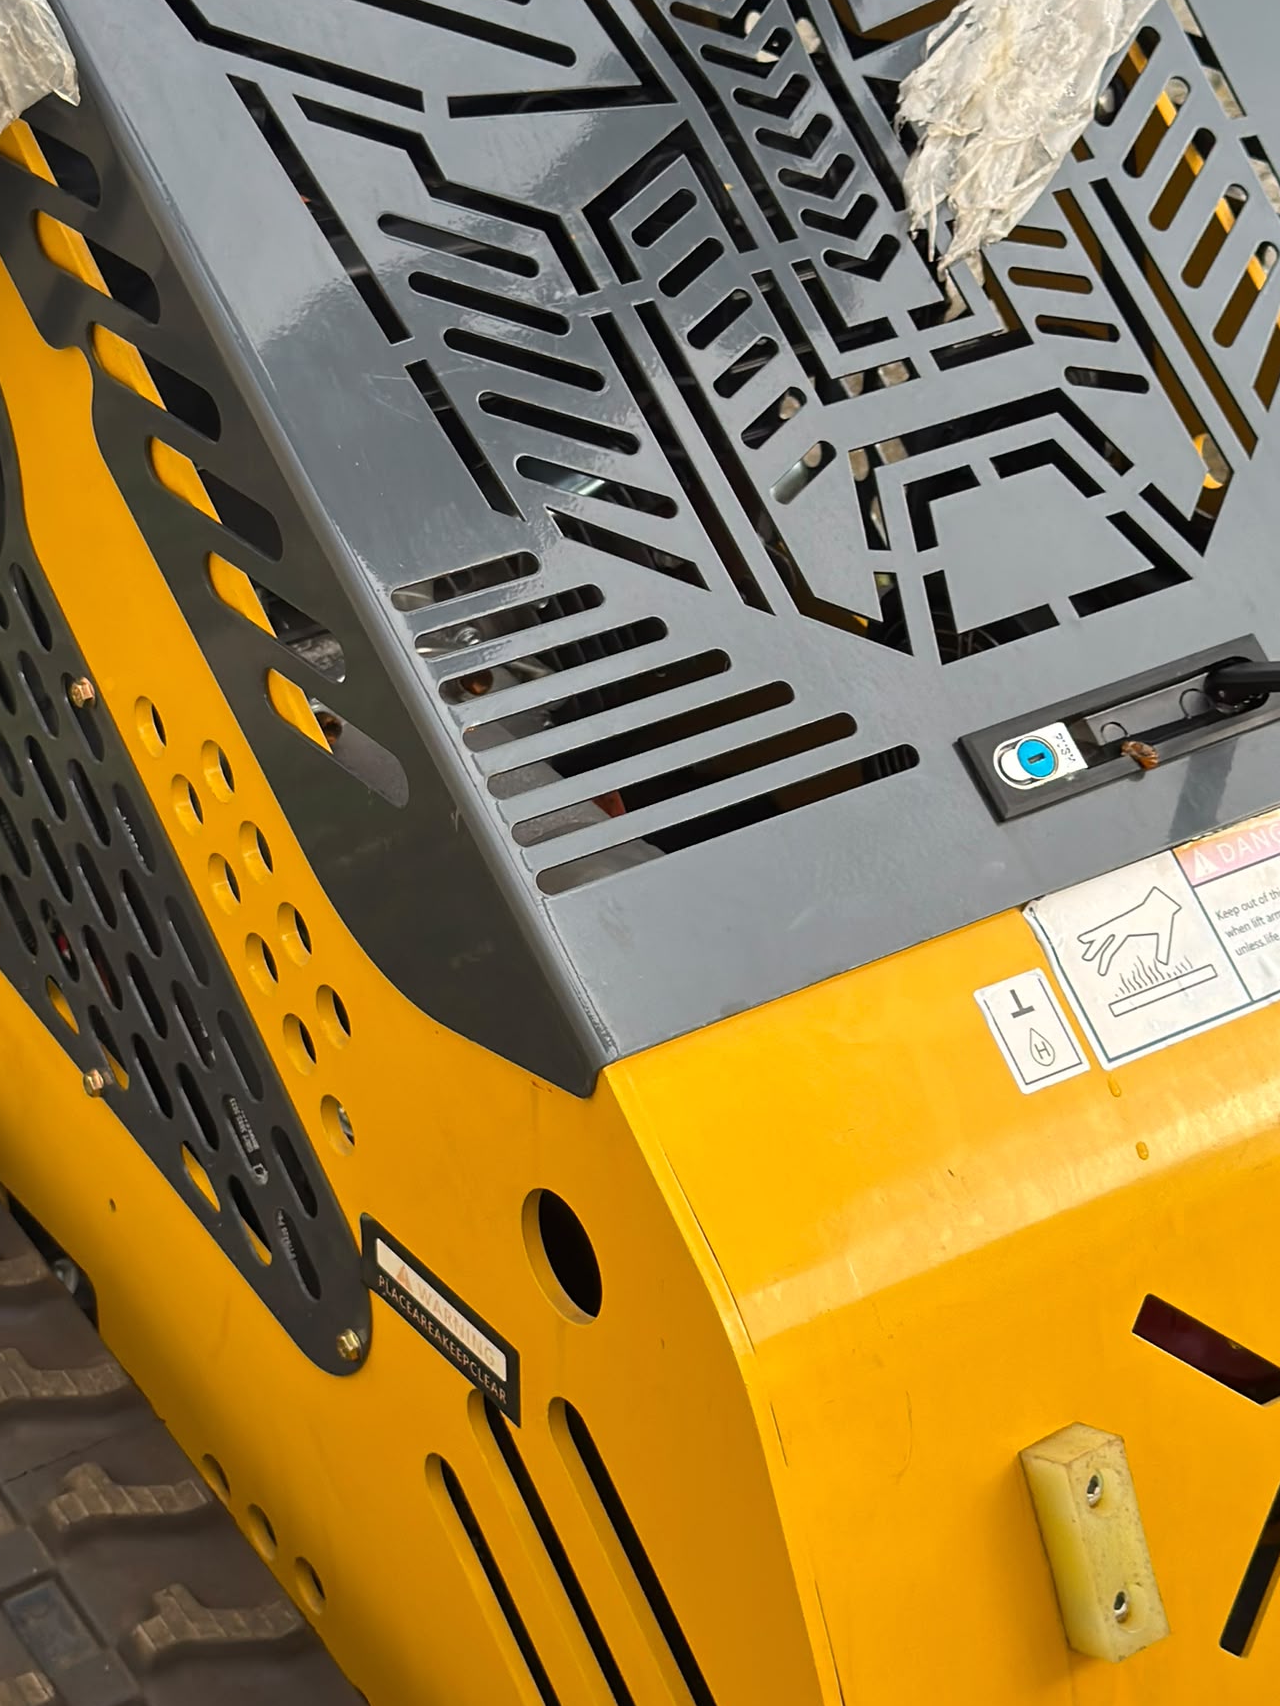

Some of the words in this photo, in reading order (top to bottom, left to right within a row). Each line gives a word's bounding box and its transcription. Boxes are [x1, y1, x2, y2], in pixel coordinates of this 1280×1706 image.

[1215, 906, 1240, 922] Keep
[1241, 898, 1258, 911] out
[1258, 892, 1269, 905] of
[1225, 922, 1251, 939] when
[1251, 915, 1266, 929] lift
[1235, 938, 1264, 956] unless
[418, 1287, 496, 1367] WARNING
